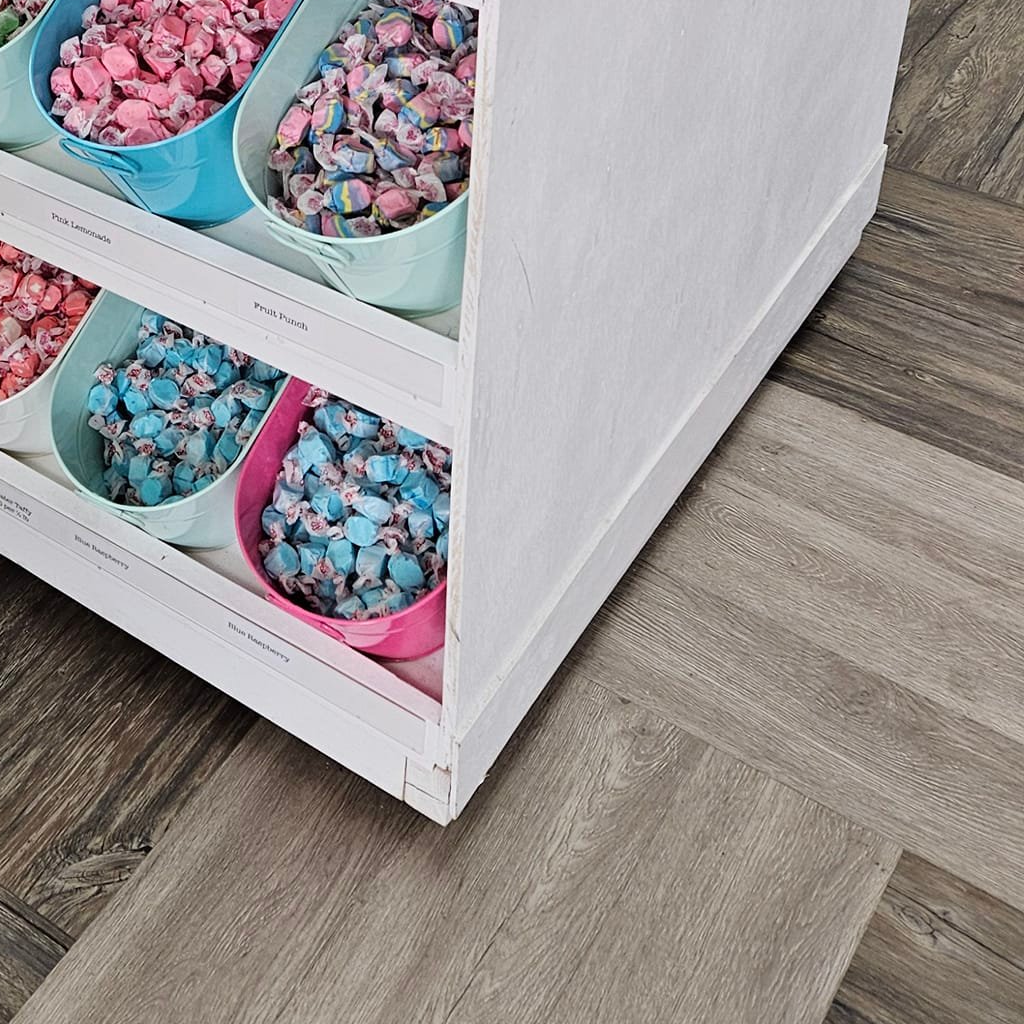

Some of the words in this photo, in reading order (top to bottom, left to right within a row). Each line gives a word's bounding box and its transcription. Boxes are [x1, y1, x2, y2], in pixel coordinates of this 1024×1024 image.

[51, 212, 70, 227] Pink
[70, 220, 112, 245] Lemonade
[253, 301, 278, 319] Fruit
[278, 311, 309, 331] Punch
[15, 501, 33, 517] Taffy
[91, 543, 130, 571] Raspberry
[228, 621, 247, 638] Blue
[247, 633, 291, 663] Raspberry
